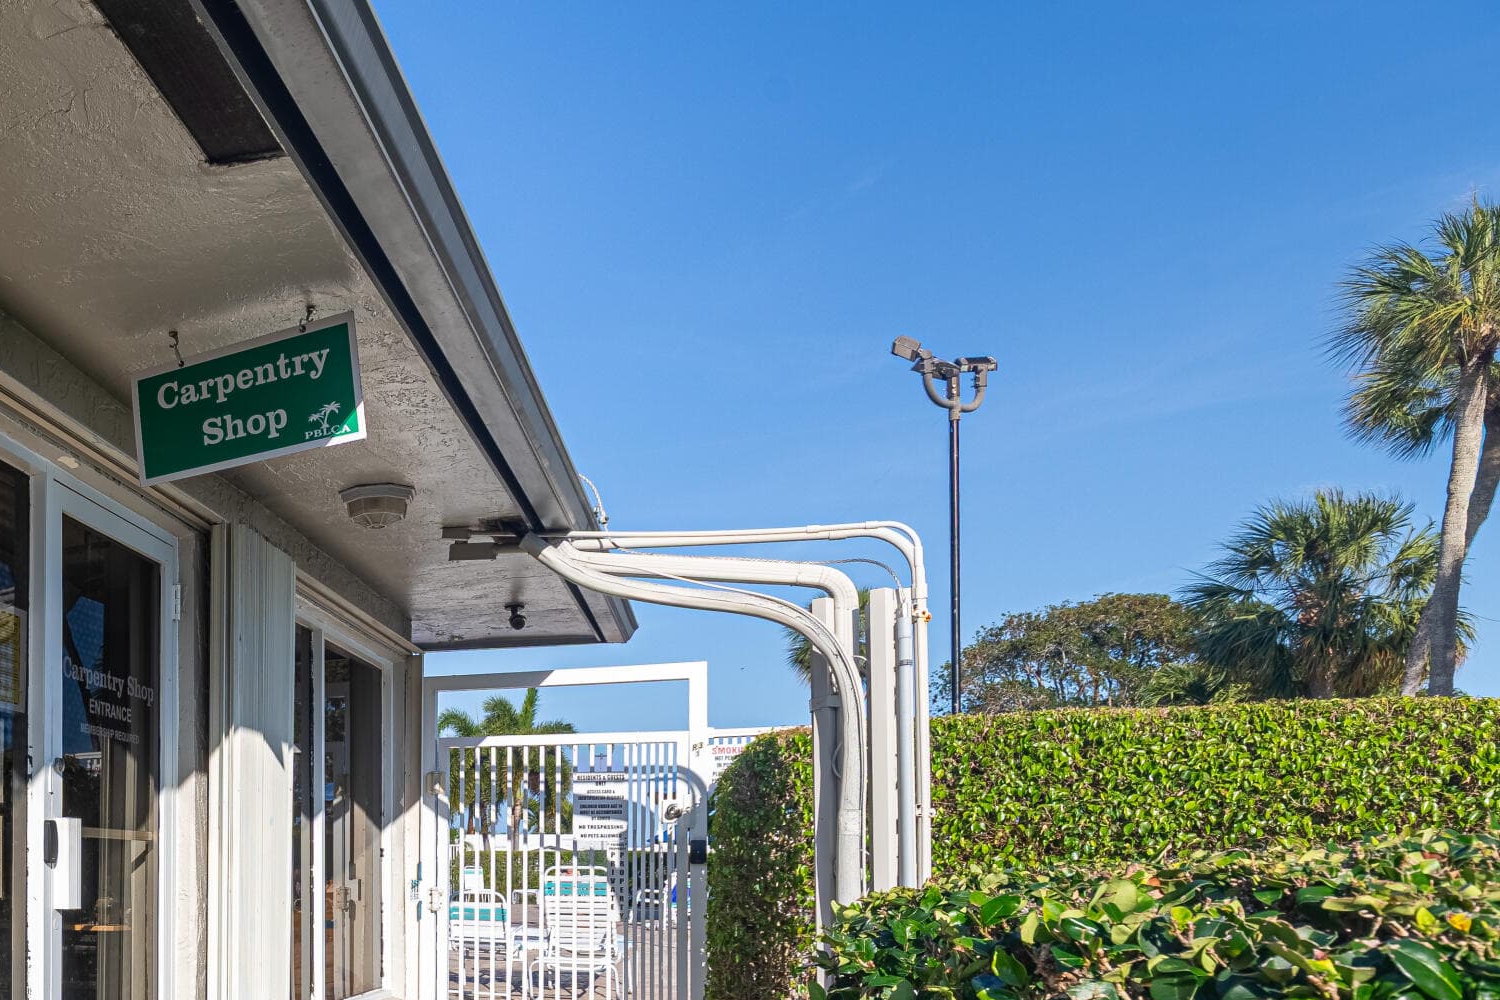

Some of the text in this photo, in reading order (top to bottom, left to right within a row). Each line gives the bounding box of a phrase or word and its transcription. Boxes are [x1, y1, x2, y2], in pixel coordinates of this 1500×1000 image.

[157, 348, 329, 409] Carpentry
[203, 408, 287, 446] Shop
[304, 424, 352, 440] PBLCA
[63, 656, 154, 706] Carpentry Shop
[89, 699, 132, 722] ENTRANCE
[115, 731, 139, 744] REQUIRED
